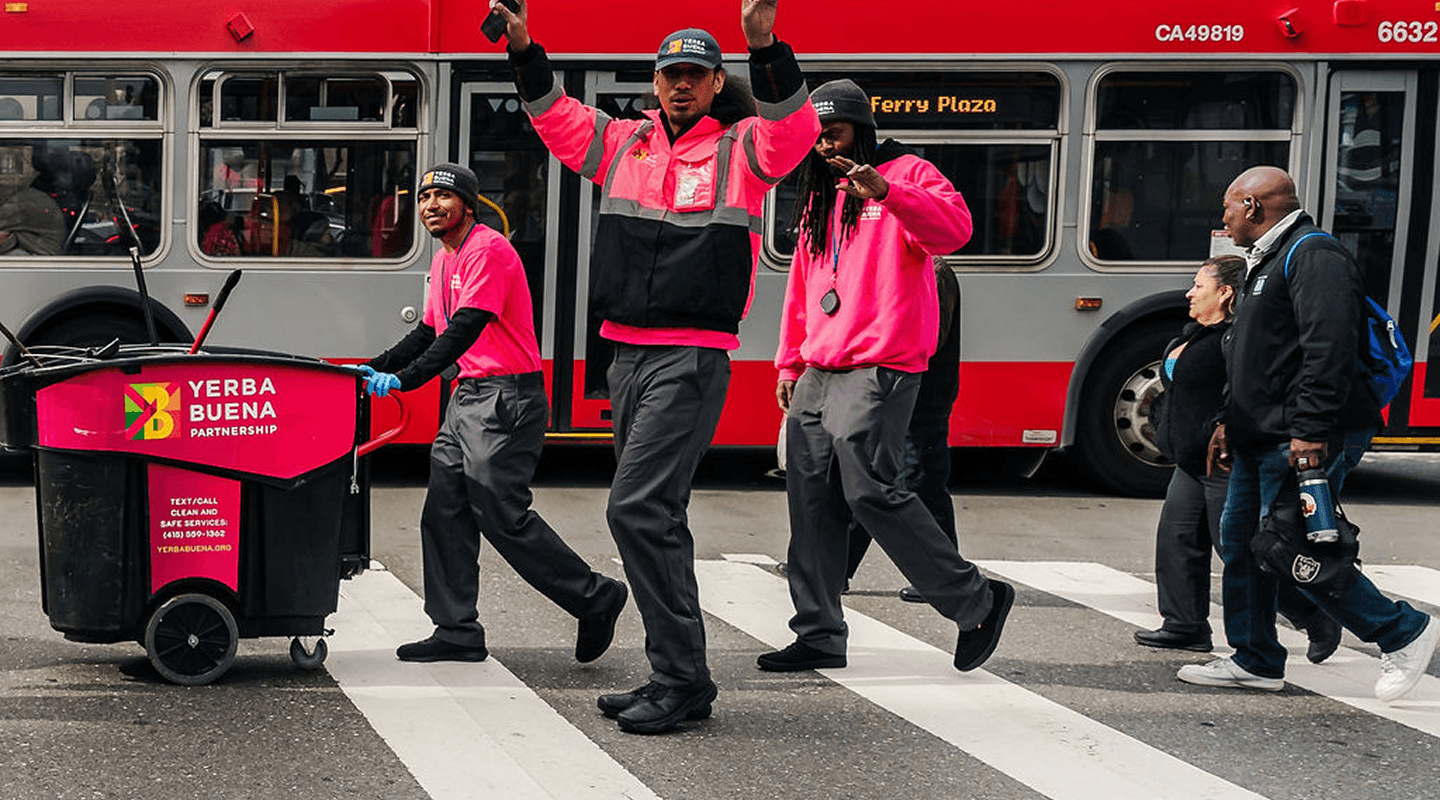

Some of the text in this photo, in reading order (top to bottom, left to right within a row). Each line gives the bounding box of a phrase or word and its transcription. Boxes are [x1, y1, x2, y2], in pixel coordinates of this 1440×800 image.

[1155, 24, 1244, 42] CA49819
[1377, 20, 1438, 43] 6632
[870, 96, 997, 113] Ferry Plaza
[188, 377, 277, 398] YERBA
[189, 401, 277, 422] BUENA
[190, 425, 278, 438] PARTNERSHIP
[170, 497, 218, 506] TEXT/CALL
[170, 508, 218, 517] CLEAN AND
[160, 519, 183, 529] SAFE
[162, 531, 184, 539] (415)
[157, 544, 232, 553] YERBABUENA.ORG
